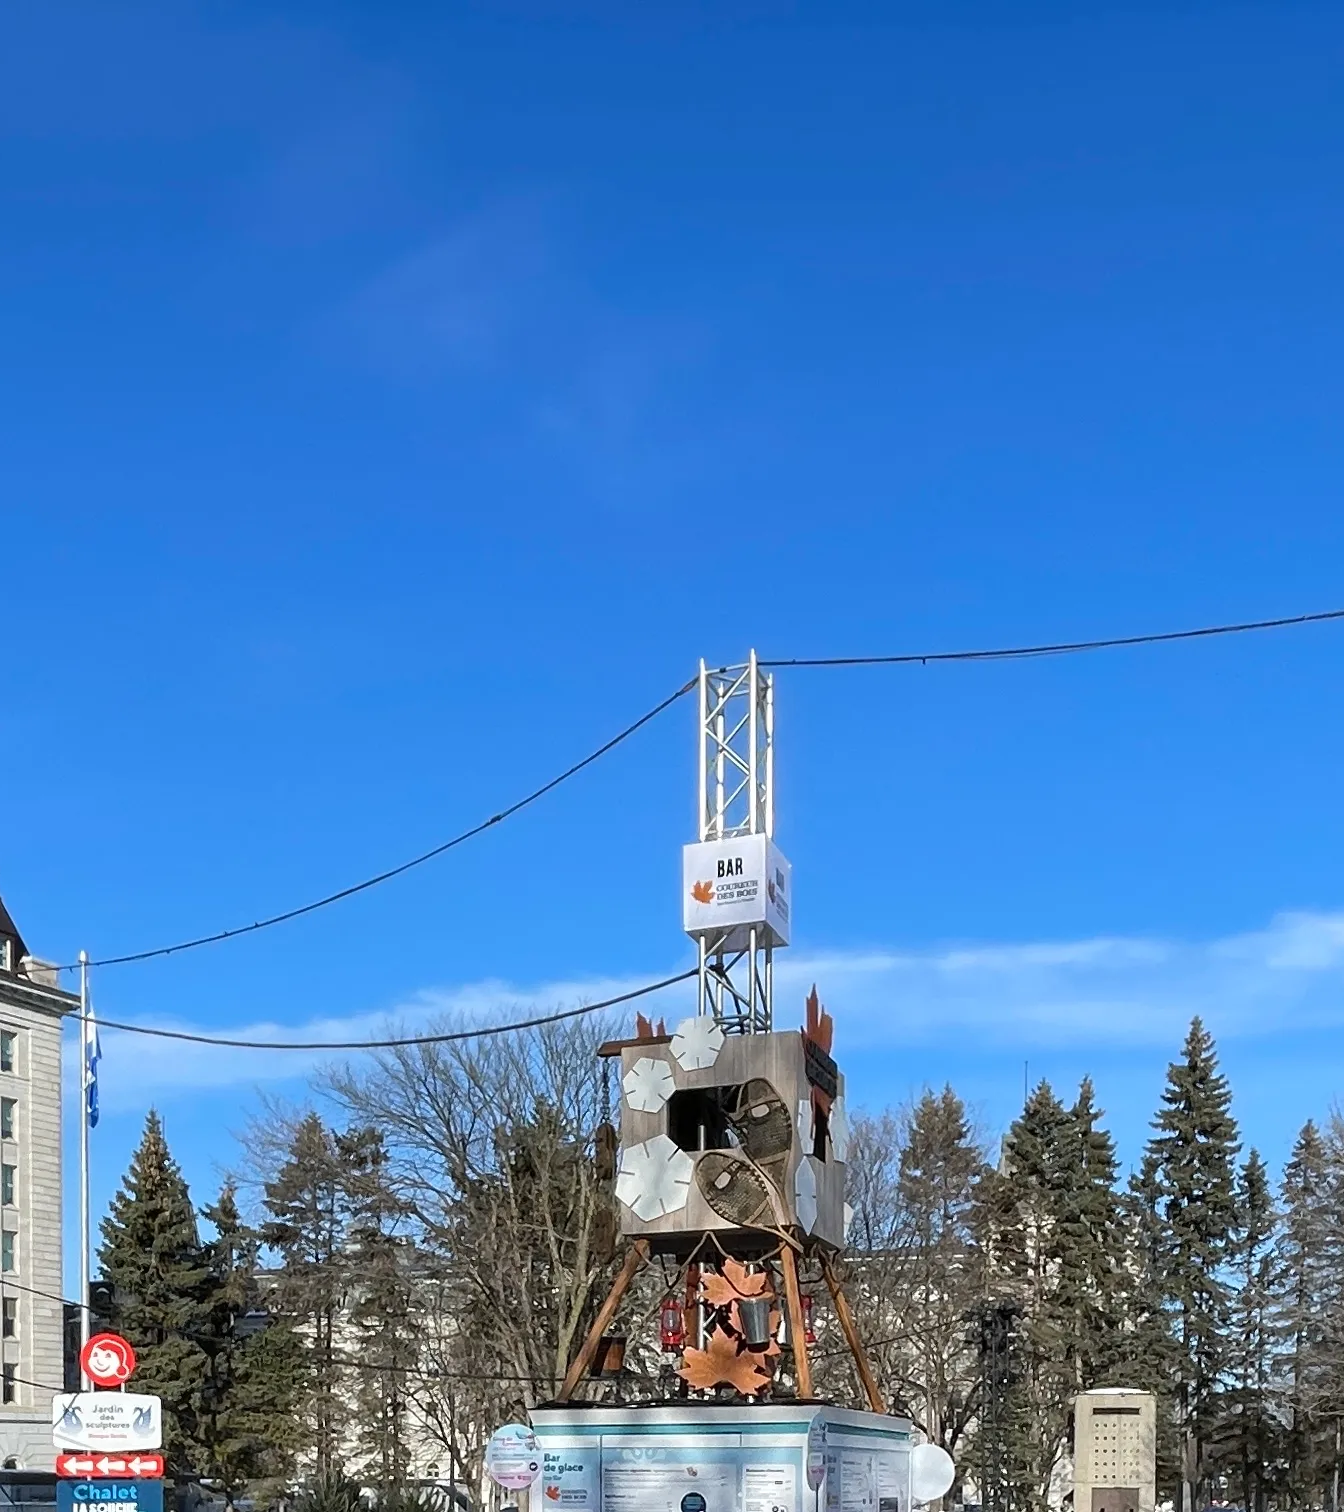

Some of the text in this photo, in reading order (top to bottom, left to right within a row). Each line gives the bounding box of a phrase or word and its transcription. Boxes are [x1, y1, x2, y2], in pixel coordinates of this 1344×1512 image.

[717, 857, 743, 878] BAR
[92, 1404, 124, 1414] Jardin
[85, 1421, 131, 1430] sculptures
[543, 1453, 560, 1462] Bar
[543, 1463, 584, 1474] de glace
[73, 1484, 138, 1500] Chalet
